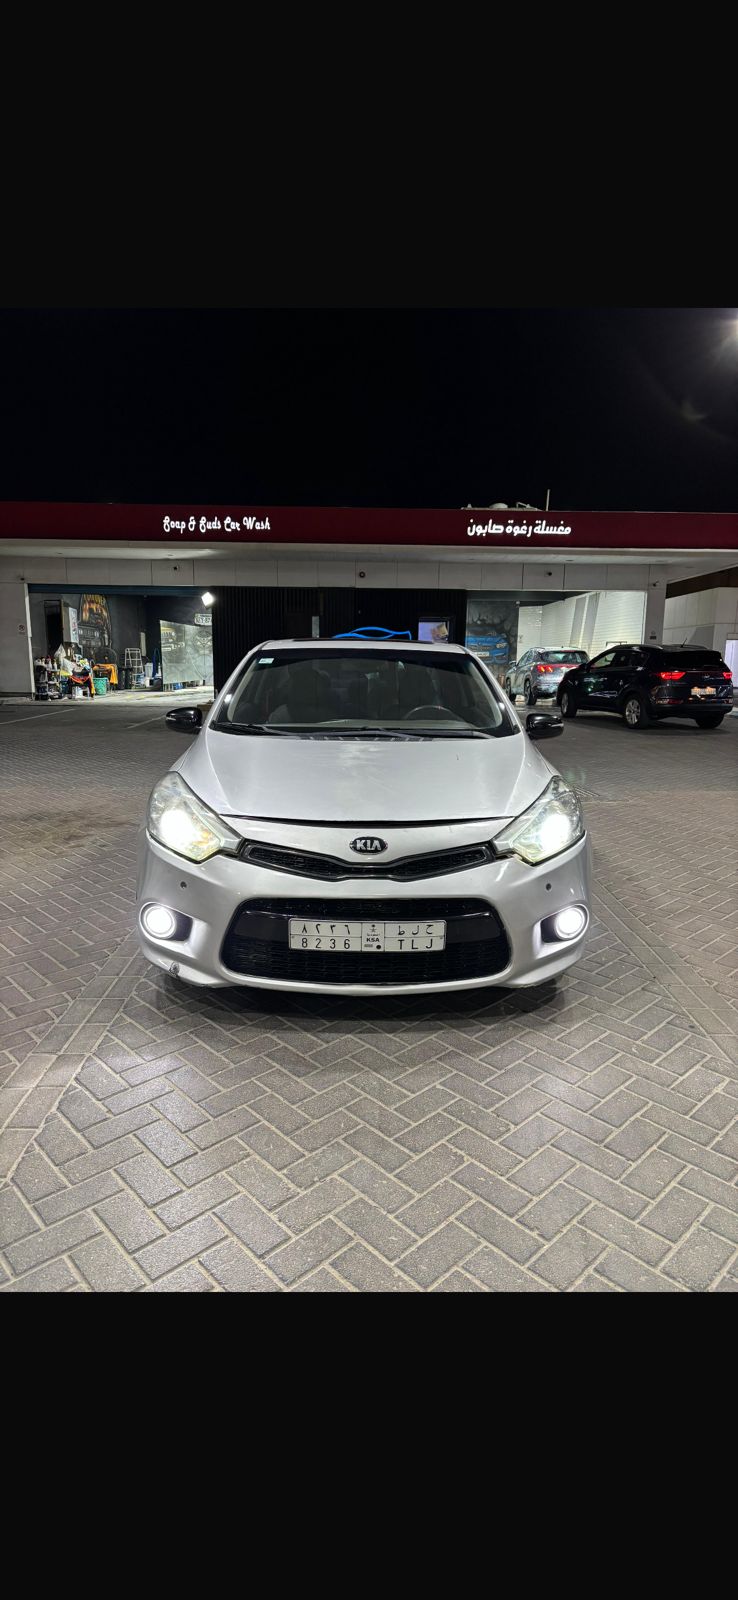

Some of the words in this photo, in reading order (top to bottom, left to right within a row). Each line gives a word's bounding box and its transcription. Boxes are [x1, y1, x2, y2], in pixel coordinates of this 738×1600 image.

[163, 516, 186, 534] Soap
[188, 516, 196, 531] &
[199, 516, 221, 533] Suds
[224, 516, 241, 532] Car
[243, 516, 271, 530] Wash
[467, 519, 504, 537] صابون
[505, 520, 533, 538] رغوة
[534, 520, 572, 535] مغسلة
[356, 839, 382, 851] KIA
[301, 937, 351, 950] 8236
